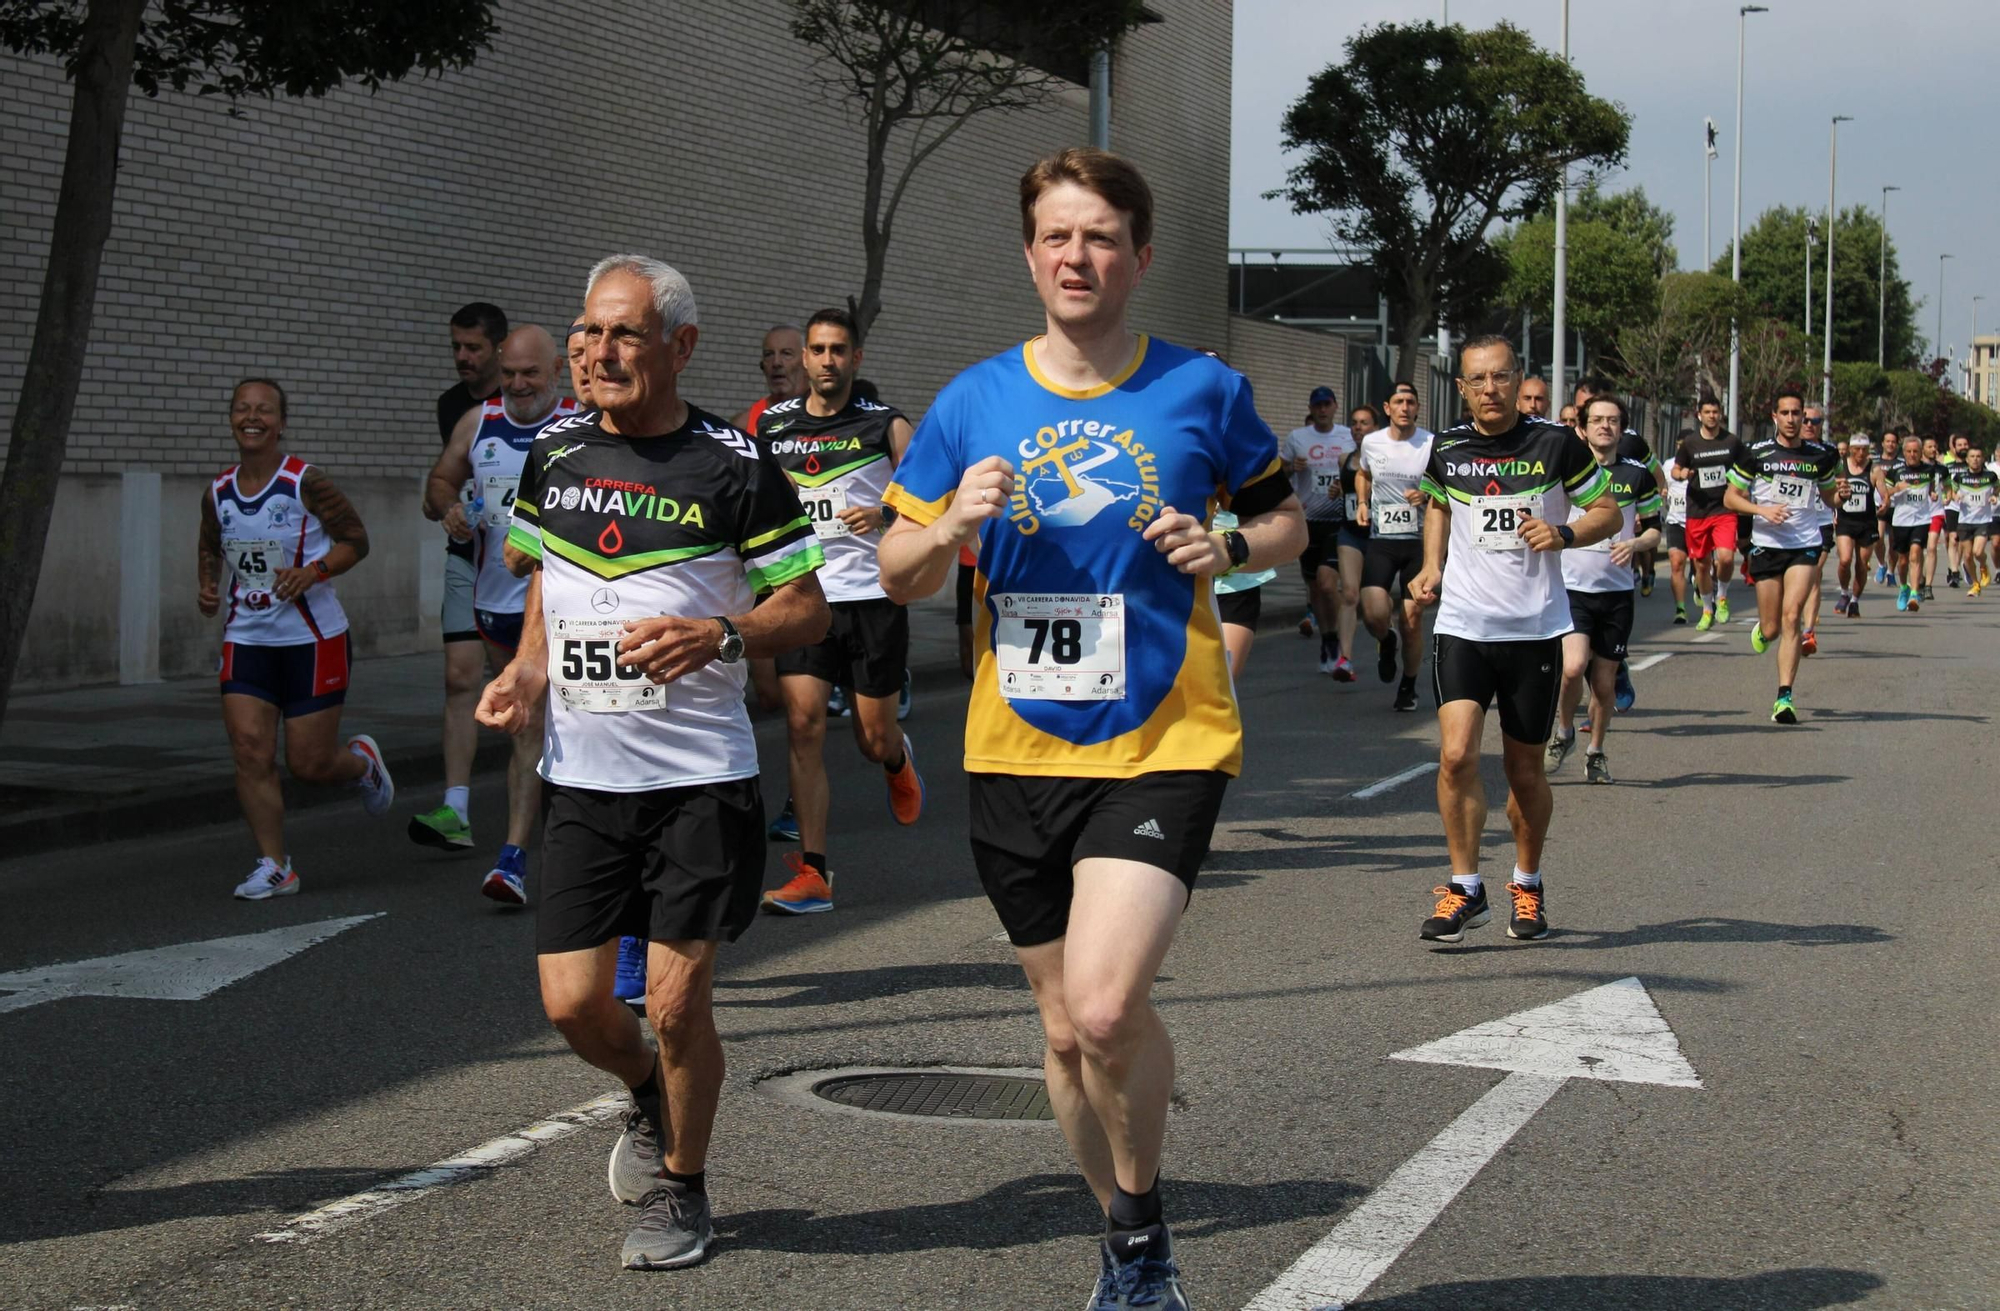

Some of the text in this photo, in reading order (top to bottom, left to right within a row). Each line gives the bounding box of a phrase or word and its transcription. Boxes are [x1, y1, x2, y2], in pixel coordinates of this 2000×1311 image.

[771, 436, 862, 455] DONAVIDA
[1445, 460, 1546, 477] DONAVIDA
[1703, 471, 1722, 481] 567
[1763, 462, 1818, 473] DONAVIDA
[585, 477, 657, 496] CARRERA
[1111, 429, 1165, 532] Asturias
[1778, 481, 1804, 498] 521
[543, 486, 705, 529] DONAVIDA
[803, 499, 833, 522] 20
[1384, 510, 1411, 524] 249
[238, 552, 268, 573] 45
[1091, 609, 1119, 617] Adarsa
[1024, 619, 1082, 664] 78
[1091, 686, 1119, 694] Adarsa
[1133, 828, 1165, 840] adidas
